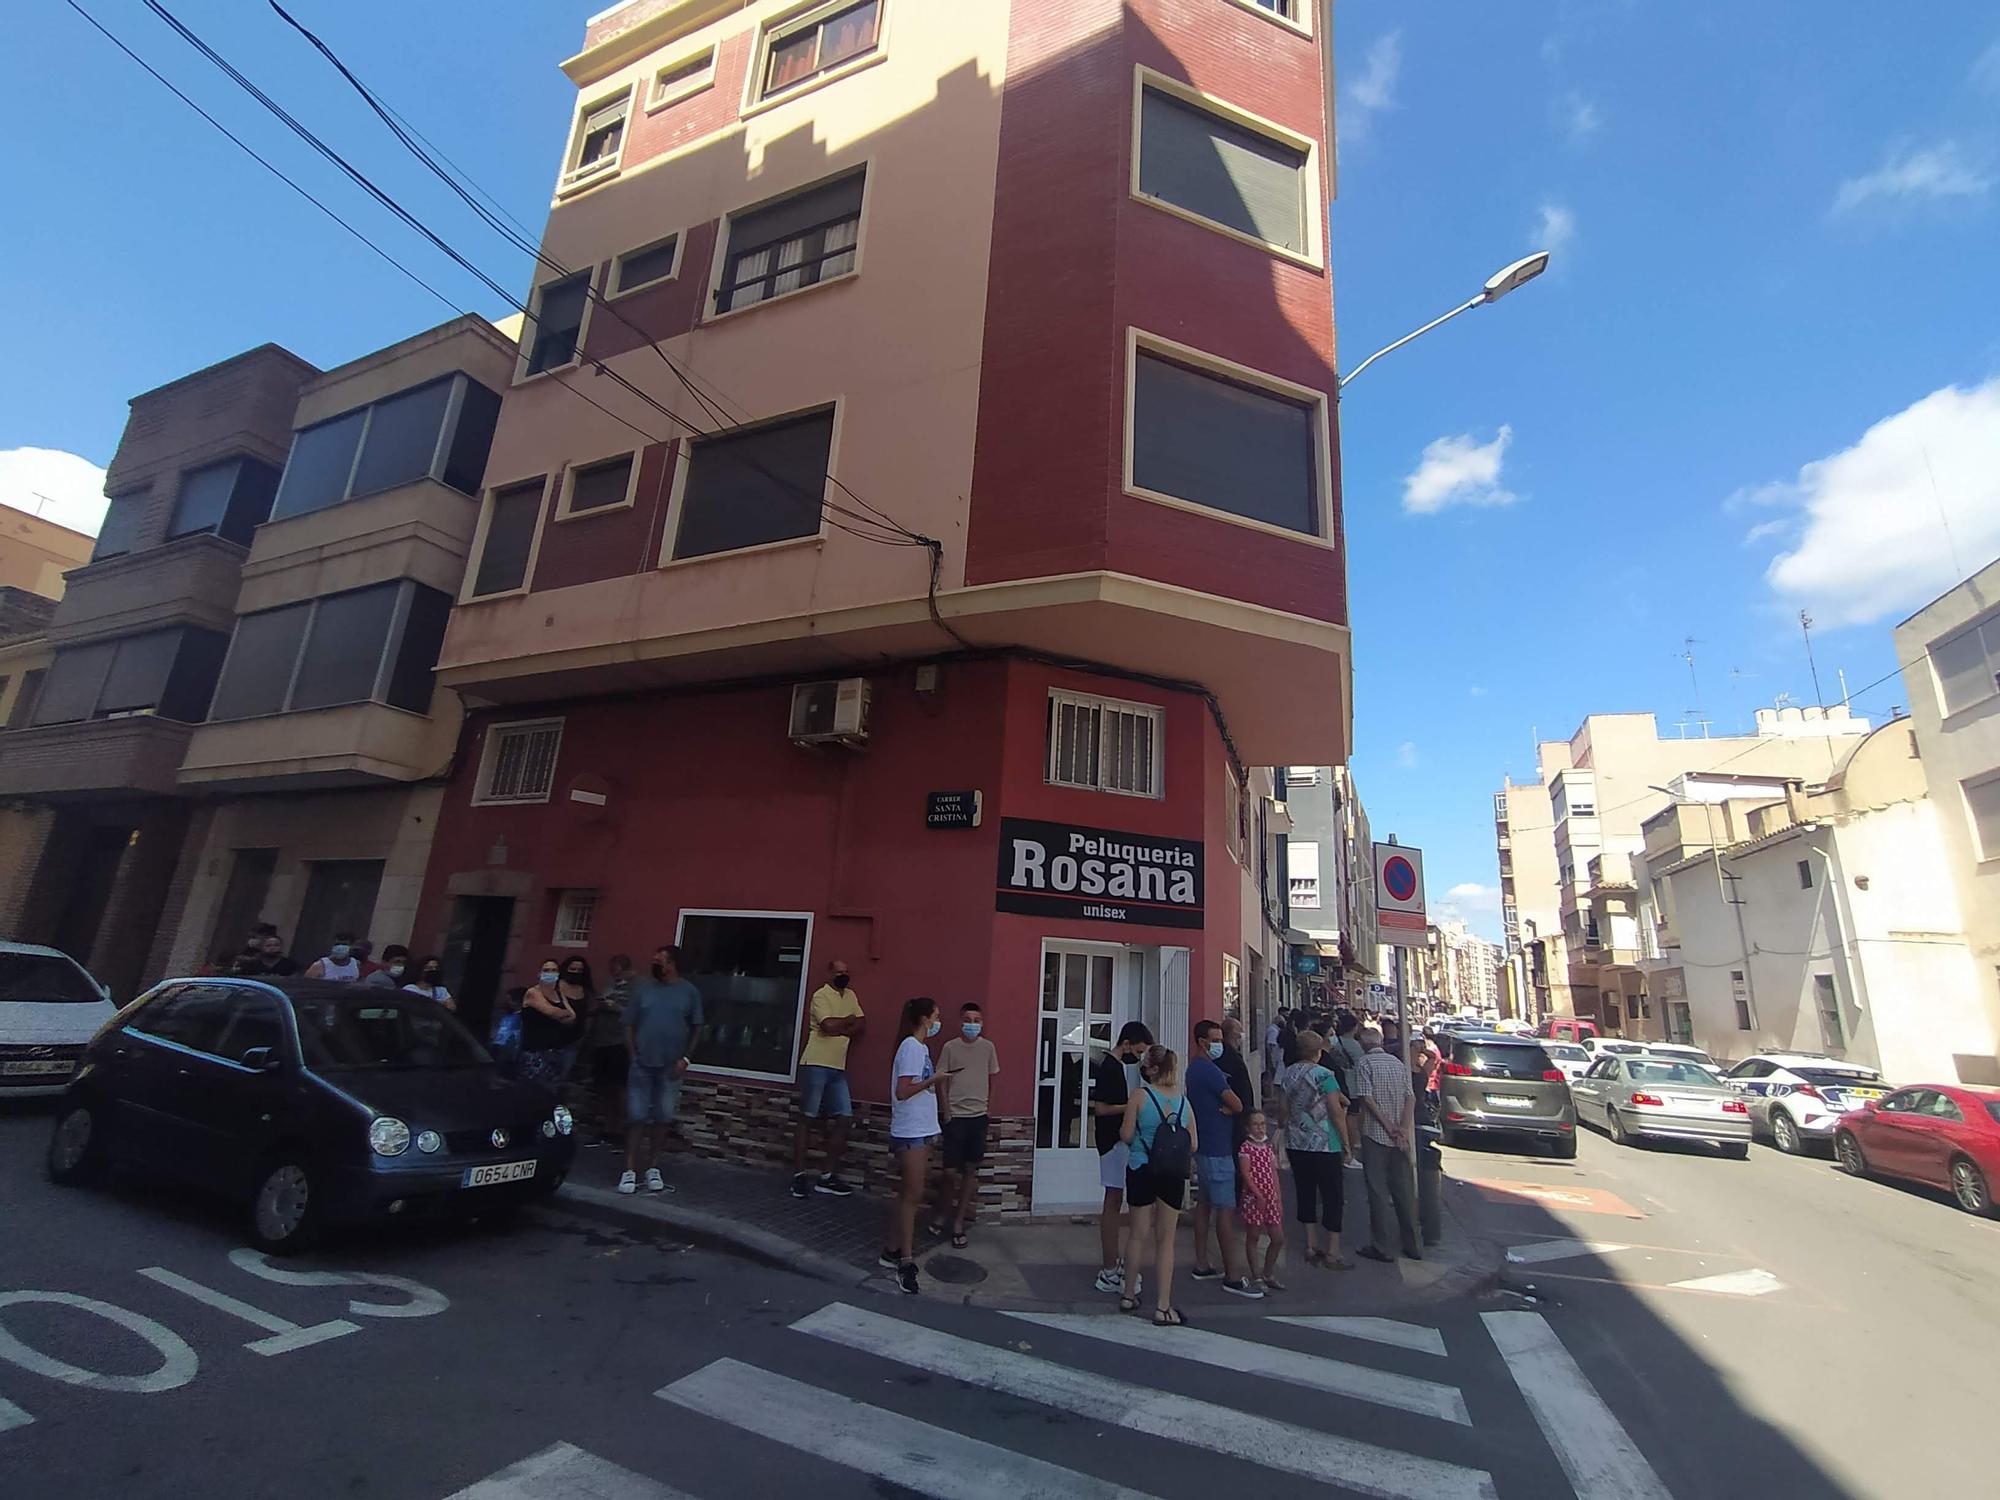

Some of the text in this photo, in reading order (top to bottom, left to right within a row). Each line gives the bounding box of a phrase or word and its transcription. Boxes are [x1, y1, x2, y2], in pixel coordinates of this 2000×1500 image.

[928, 813, 968, 822] CRISTINA
[935, 804, 961, 812] SANTA
[1069, 833, 1195, 867] Peluqueria
[1010, 839, 1195, 904] Rosana
[1083, 904, 1127, 920] unisex
[474, 1162, 535, 1184] 0654 CNR
